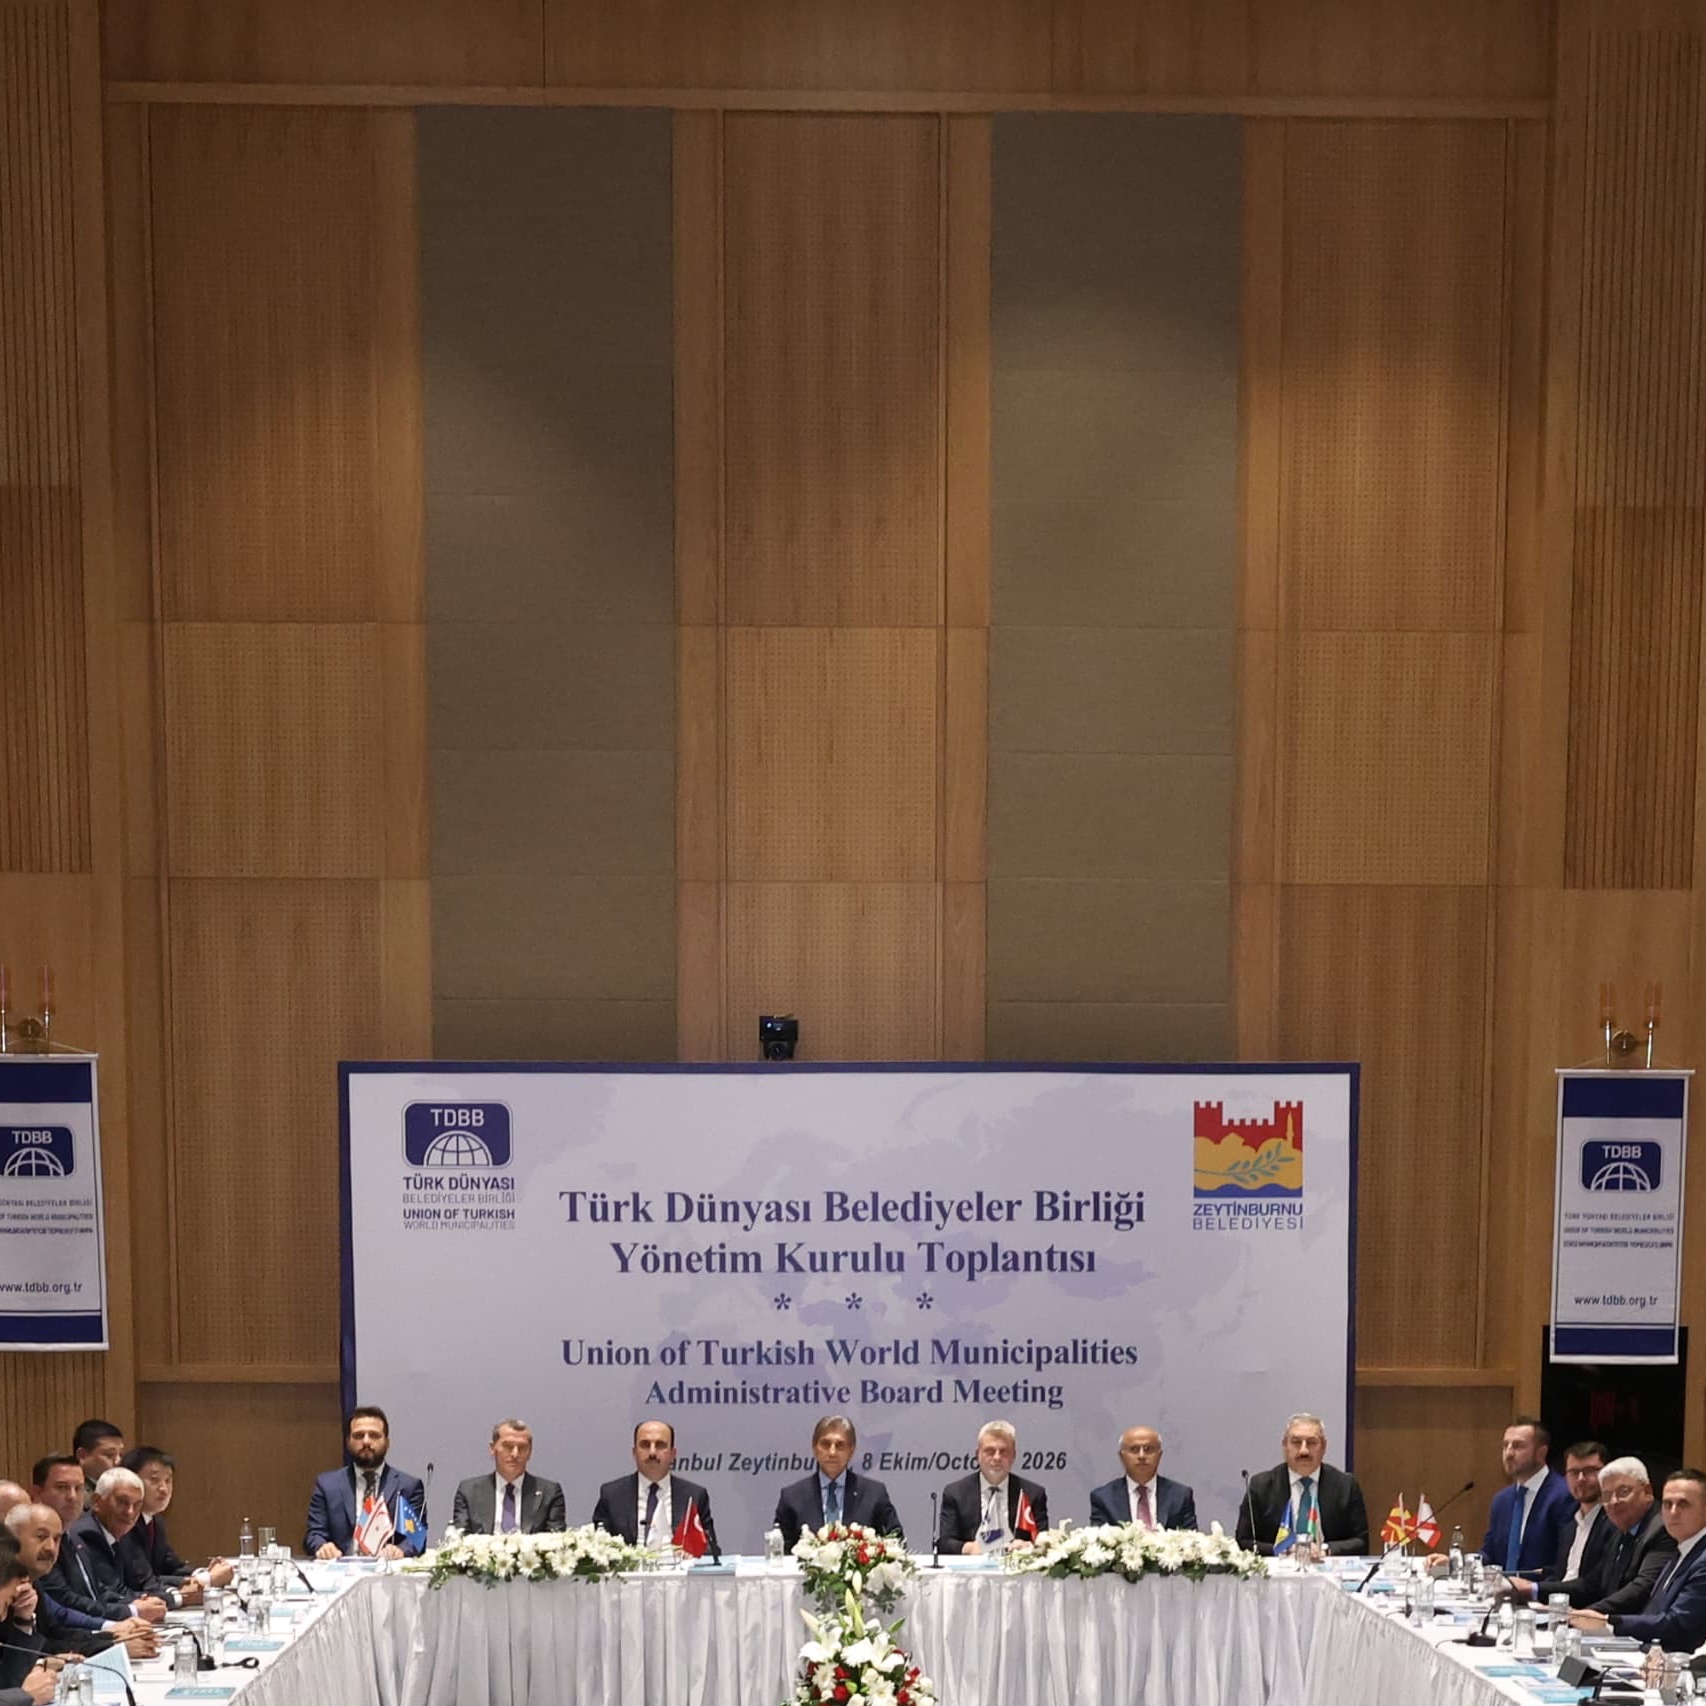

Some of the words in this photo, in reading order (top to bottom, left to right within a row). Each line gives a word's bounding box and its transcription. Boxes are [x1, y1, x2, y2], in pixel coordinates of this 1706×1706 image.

[430, 1108, 485, 1127] TDBB
[11, 1130, 53, 1145] TDBB
[1601, 1145, 1643, 1160] TDBB
[402, 1173, 445, 1191] TÜRK
[448, 1173, 516, 1191] DÜNYASI
[403, 1207, 442, 1220] UNION
[444, 1207, 460, 1220] OF
[462, 1207, 516, 1220] TURKISH
[559, 1191, 653, 1223] Türk
[666, 1190, 812, 1233] Dünyası
[825, 1189, 1023, 1232] Belediyeler
[1035, 1189, 1146, 1233] Birliği
[1193, 1201, 1304, 1217] ZEYTİNBURNU
[1193, 1216, 1304, 1231] BELEDİYESİ
[610, 1241, 763, 1275] Yönetim
[776, 1241, 906, 1275] Kurulu
[916, 1241, 1096, 1283] Toplantısı
[562, 1339, 651, 1366] Union
[660, 1339, 691, 1366] of
[697, 1339, 815, 1366] Turkish
[826, 1339, 920, 1366] World
[929, 1338, 1139, 1372] Municipalities
[645, 1379, 852, 1405] Administrative
[860, 1379, 943, 1405] Board
[953, 1378, 1064, 1409] Meeting
[861, 1452, 873, 1472] 8
[879, 1451, 981, 1472] Ekim/Octo
[1020, 1451, 1068, 1472] 2026
